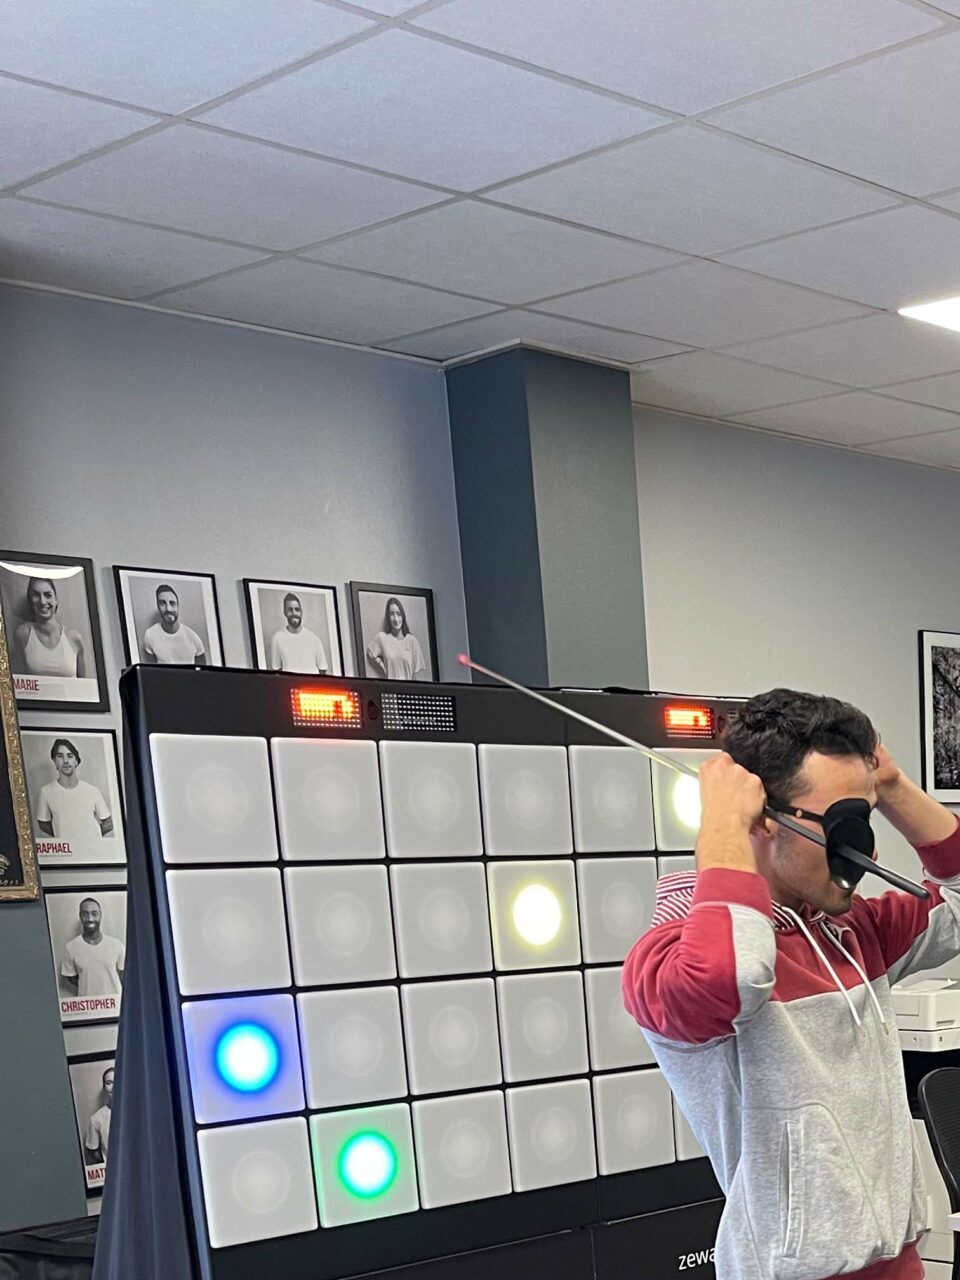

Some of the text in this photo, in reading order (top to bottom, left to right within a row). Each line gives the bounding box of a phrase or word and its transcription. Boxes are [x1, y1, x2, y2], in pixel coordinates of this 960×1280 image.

[15, 679, 40, 691] MARIE
[36, 842, 72, 854] RAPHAEL
[61, 998, 116, 1012] CHRISTOPHER
